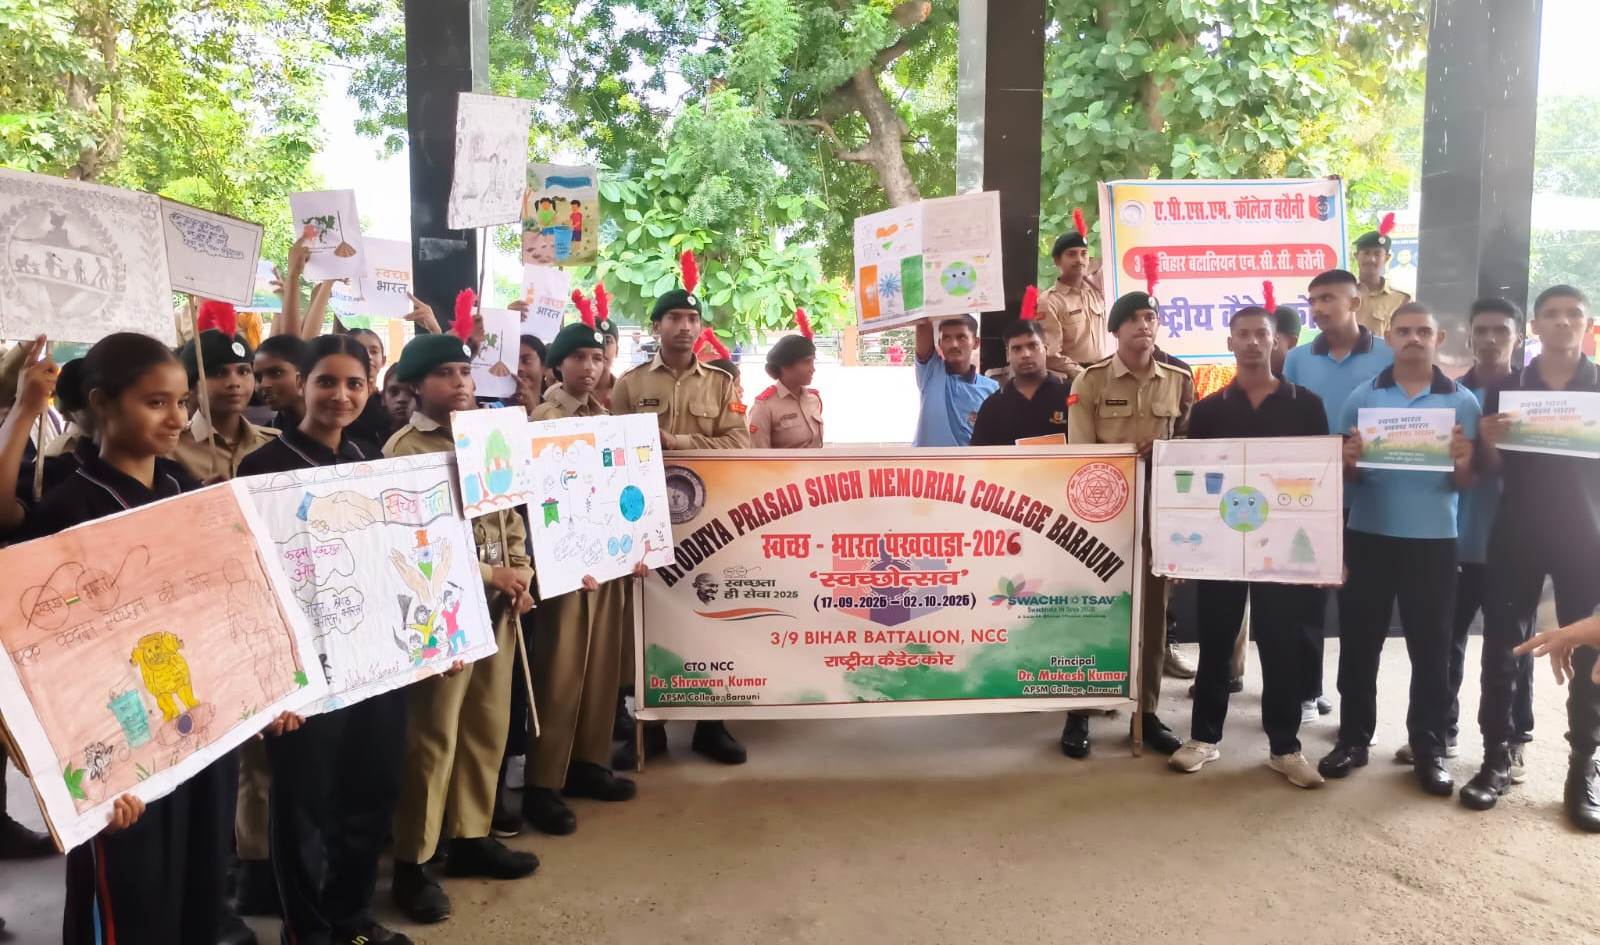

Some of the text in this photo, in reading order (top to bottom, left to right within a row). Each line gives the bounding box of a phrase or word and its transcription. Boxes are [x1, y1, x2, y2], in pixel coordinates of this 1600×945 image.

[1153, 193, 1305, 220] ए.पी.एस.एम. कॉलेज बरौनी
[1188, 252, 1236, 272] बटालियन
[1239, 250, 1293, 271] एन.सी.सी.
[1297, 249, 1325, 270] बरौनी
[376, 280, 408, 294] भारत
[536, 305, 561, 319] भारत
[1158, 297, 1214, 338] ष्ट्रीय
[656, 517, 734, 588] AYODHYA
[727, 483, 804, 537] PRASAD
[804, 469, 864, 508] SINGH
[868, 467, 966, 505] MEMORIAL
[970, 479, 1053, 535] COLLEGE
[1045, 513, 1125, 583] BARAUNI
[760, 533, 812, 559] स्वच्छ
[832, 532, 882, 558] भारत
[724, 579, 776, 588] स्वच्छता
[723, 587, 799, 599] ही सेवा 2025
[770, 628, 1007, 648] 3/9 BIHAR BATTALION, NCC
[684, 661, 735, 671] CTO NCC
[824, 650, 955, 671] राष्ट्रीय कैडेट कोर
[1051, 655, 1095, 668] Principal
[651, 675, 768, 688] Dr. Shrawan Kumar
[1018, 668, 1127, 681] Dr. Mukesh Kumar
[1023, 685, 1048, 694] APSM
[1087, 685, 1122, 694] Barauni
[659, 693, 685, 702] APSM
[726, 692, 760, 701] Barauni
